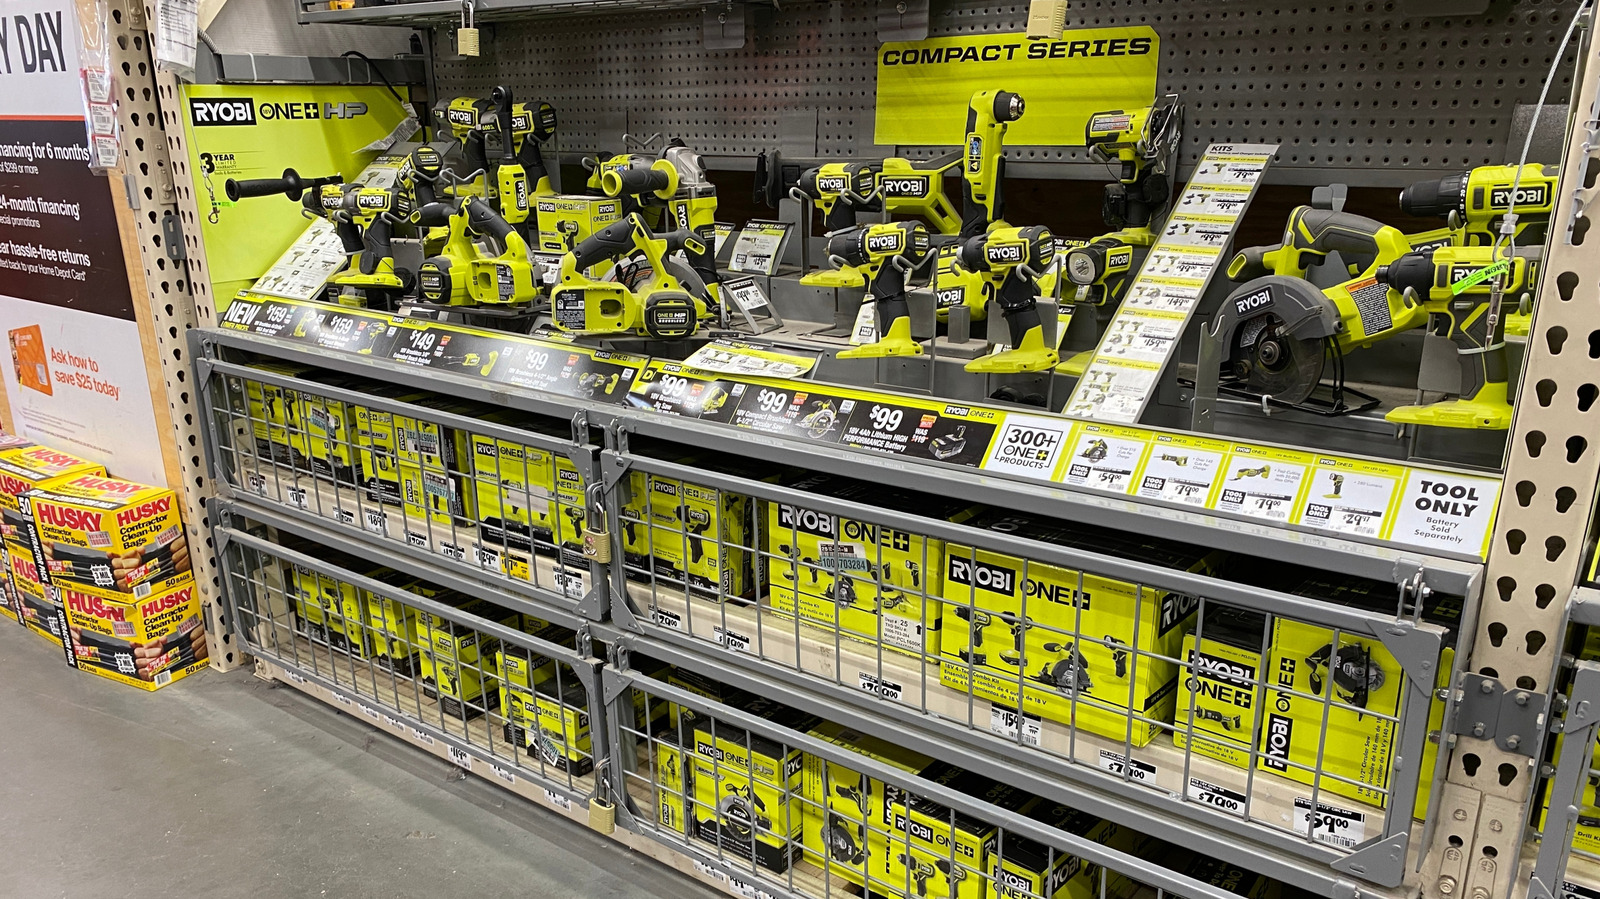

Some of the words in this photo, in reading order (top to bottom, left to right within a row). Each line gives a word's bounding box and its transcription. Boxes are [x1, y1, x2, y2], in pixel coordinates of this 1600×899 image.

[14, 11, 67, 73] DAY
[882, 43, 1021, 66] COMPACT
[1027, 37, 1152, 60] SERIES
[192, 102, 254, 122] RYOBI
[323, 102, 368, 119] HP
[450, 110, 472, 123] RYOBI
[33, 142, 45, 159] for
[46, 143, 53, 159] 6
[54, 144, 89, 161] months
[4, 162, 18, 172] $299
[25, 164, 39, 174] more
[200, 153, 215, 174] 3
[819, 178, 844, 189] RYOBI
[884, 180, 923, 192] RYOBI
[360, 195, 383, 205] RYOBI
[518, 182, 526, 207] RYOBI
[1494, 190, 1542, 204] RYOBI
[539, 203, 555, 211] RYOBI
[599, 204, 615, 213] RYOBI
[11, 217, 40, 228] promotions
[869, 235, 896, 248] RYOBI
[10, 241, 57, 261] hassle-free
[58, 250, 91, 266] returns
[988, 247, 1020, 260] RYOBI
[1110, 255, 1129, 265] RYOBI
[27, 263, 40, 275] your
[40, 264, 54, 275] Home
[55, 266, 71, 279] Depot
[1236, 290, 1270, 313] RYOBI
[224, 302, 261, 325] NEW
[267, 304, 287, 322] $159
[330, 316, 353, 334] $159
[410, 330, 435, 350] $149
[51, 347, 66, 366] Ask
[67, 351, 88, 369] how
[88, 357, 99, 372] to
[525, 350, 549, 370] $99
[595, 351, 610, 359] RYOBI
[663, 364, 682, 372] RYOBI
[54, 370, 75, 385] save
[76, 372, 92, 390] $25
[659, 374, 687, 397] $99
[756, 388, 787, 413] $99
[736, 409, 746, 417] 18V
[746, 411, 766, 420] Compact
[766, 414, 792, 423] Brushless
[869, 404, 903, 431] $99
[945, 406, 968, 416] RYOBI
[753, 420, 772, 428] Circular
[915, 428, 928, 436] WAS
[849, 427, 859, 435] 18V
[859, 429, 871, 437] 4Ah
[871, 431, 893, 440] Lithium
[893, 434, 909, 443] HIGH
[1008, 429, 1056, 447] 300+
[842, 435, 884, 449] PERFORMANCE
[884, 443, 907, 453] Battery
[27, 449, 86, 467] HUSKY
[1004, 445, 1049, 461] ONE+
[1000, 457, 1044, 469] PRODUCTS
[560, 470, 578, 480] RYOBI
[1145, 477, 1163, 485] TOOL
[68, 476, 151, 493] HUSKY
[655, 482, 675, 495] RYOBI
[1144, 482, 1162, 490] ONLY
[1420, 480, 1479, 501] TOOL
[1224, 490, 1243, 498] TOOL
[19, 497, 31, 515] 50
[117, 496, 172, 527] HUSKY
[1308, 510, 1328, 518] ONLY
[1415, 498, 1478, 518] ONLY
[37, 503, 101, 532] HUSKY
[120, 513, 168, 535] Contractor
[1426, 516, 1459, 529] Battery
[41, 524, 72, 536] Contractor
[121, 524, 162, 543] Clean-Up
[781, 504, 836, 535] RYOBI
[844, 521, 910, 552] ONE+
[1431, 524, 1450, 533] Sold
[43, 531, 71, 545] Clean-Up
[71, 536, 88, 547] Bags
[123, 537, 147, 550] Bags
[1414, 529, 1463, 544] Separately
[53, 577, 62, 587] 50
[165, 578, 176, 588] 50
[176, 574, 190, 585] BAGS
[952, 560, 1012, 591] RYOBI
[1019, 578, 1091, 611] ONE+
[142, 586, 193, 618] HUSKY
[70, 611, 99, 624] Contractor
[144, 603, 189, 626] Contractor
[72, 618, 97, 632] Clean-Up
[98, 626, 112, 636] Bags
[144, 614, 183, 634] Clean-Up
[146, 628, 170, 641] Bags
[440, 637, 452, 647] RYOBI
[79, 662, 87, 670] 50
[185, 665, 196, 675] 50
[196, 660, 210, 671] BAGS
[505, 660, 518, 668] RYOBI
[1191, 653, 1250, 686] RYOBI
[944, 669, 968, 680] Ensemble
[977, 680, 995, 688] combin
[973, 672, 991, 681] Combo
[1185, 677, 1252, 709] ONE+
[1267, 718, 1289, 769] RYOBI
[698, 743, 723, 761] RYOBI
[753, 763, 774, 776] HP
[897, 817, 932, 841] RYOBI
[995, 867, 1030, 890] RYOBI
